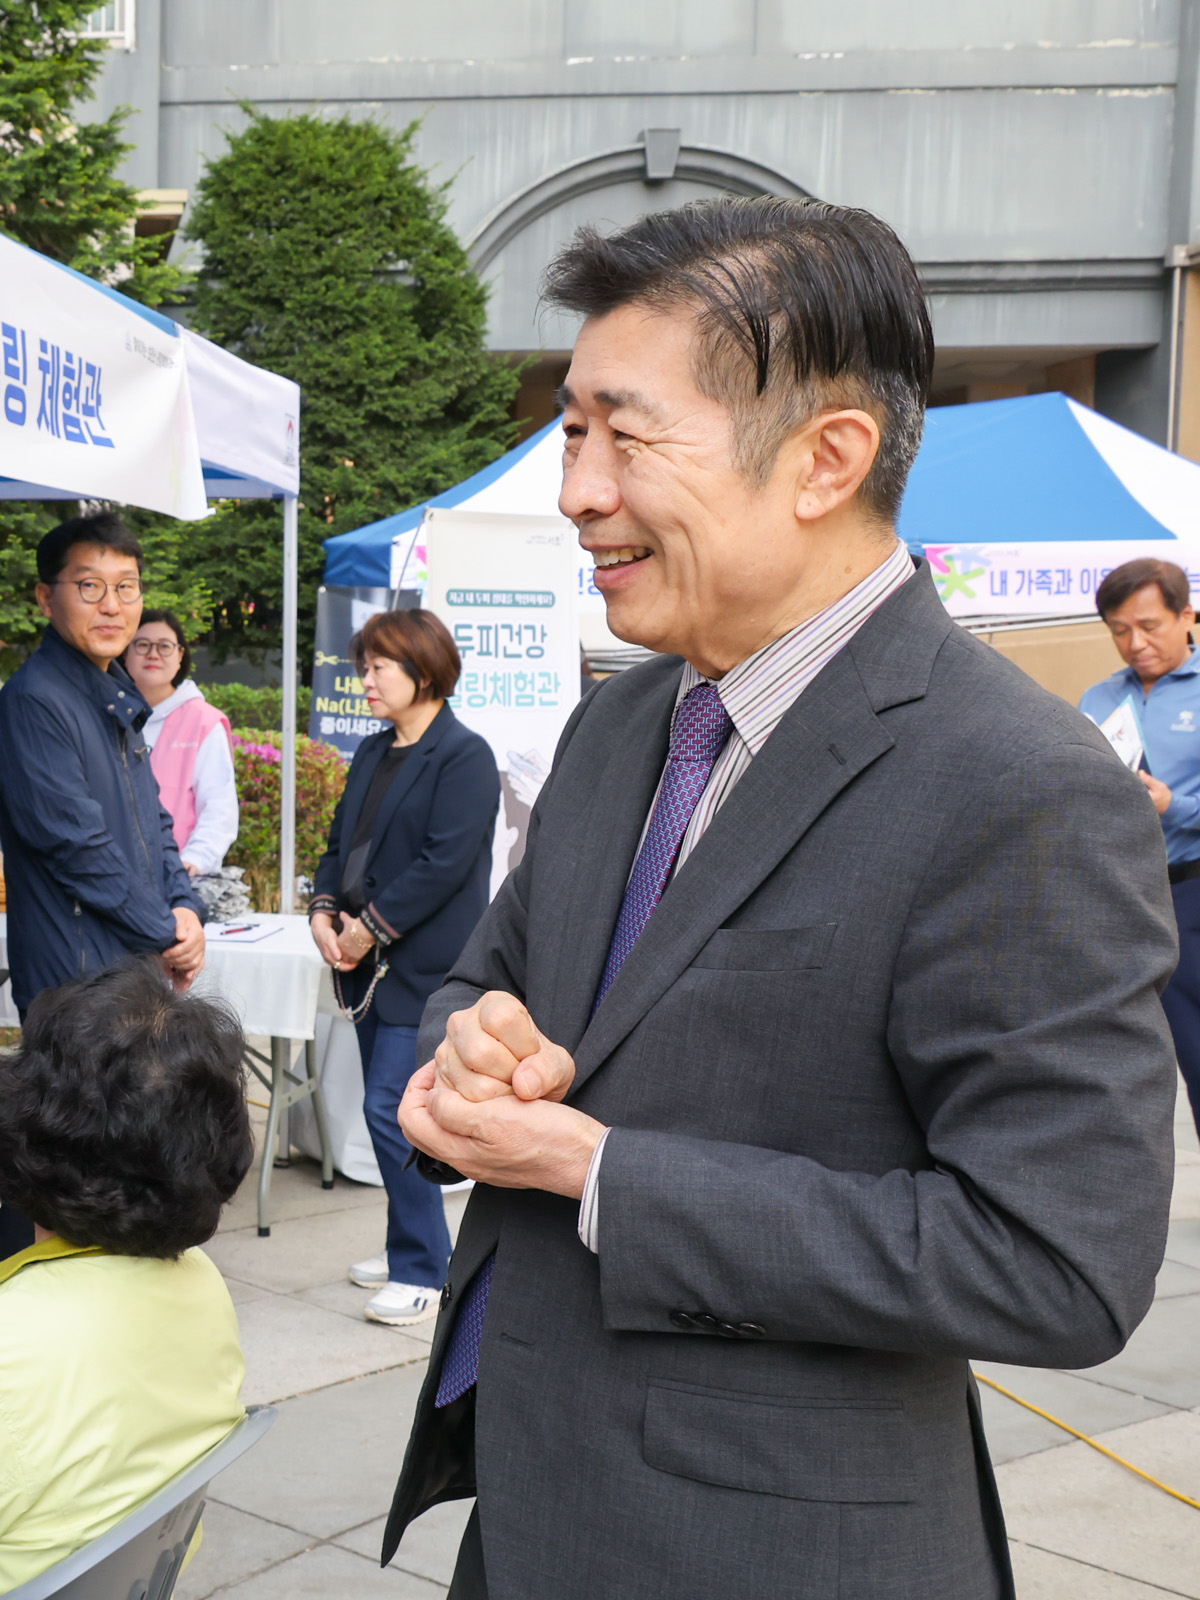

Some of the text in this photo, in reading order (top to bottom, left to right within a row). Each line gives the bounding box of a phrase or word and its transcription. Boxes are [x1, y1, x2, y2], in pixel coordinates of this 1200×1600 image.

[37, 338, 115, 449] 체험관
[990, 569, 1008, 597] 내
[1015, 569, 1073, 597] 가족과
[454, 623, 548, 659] 두피건강
